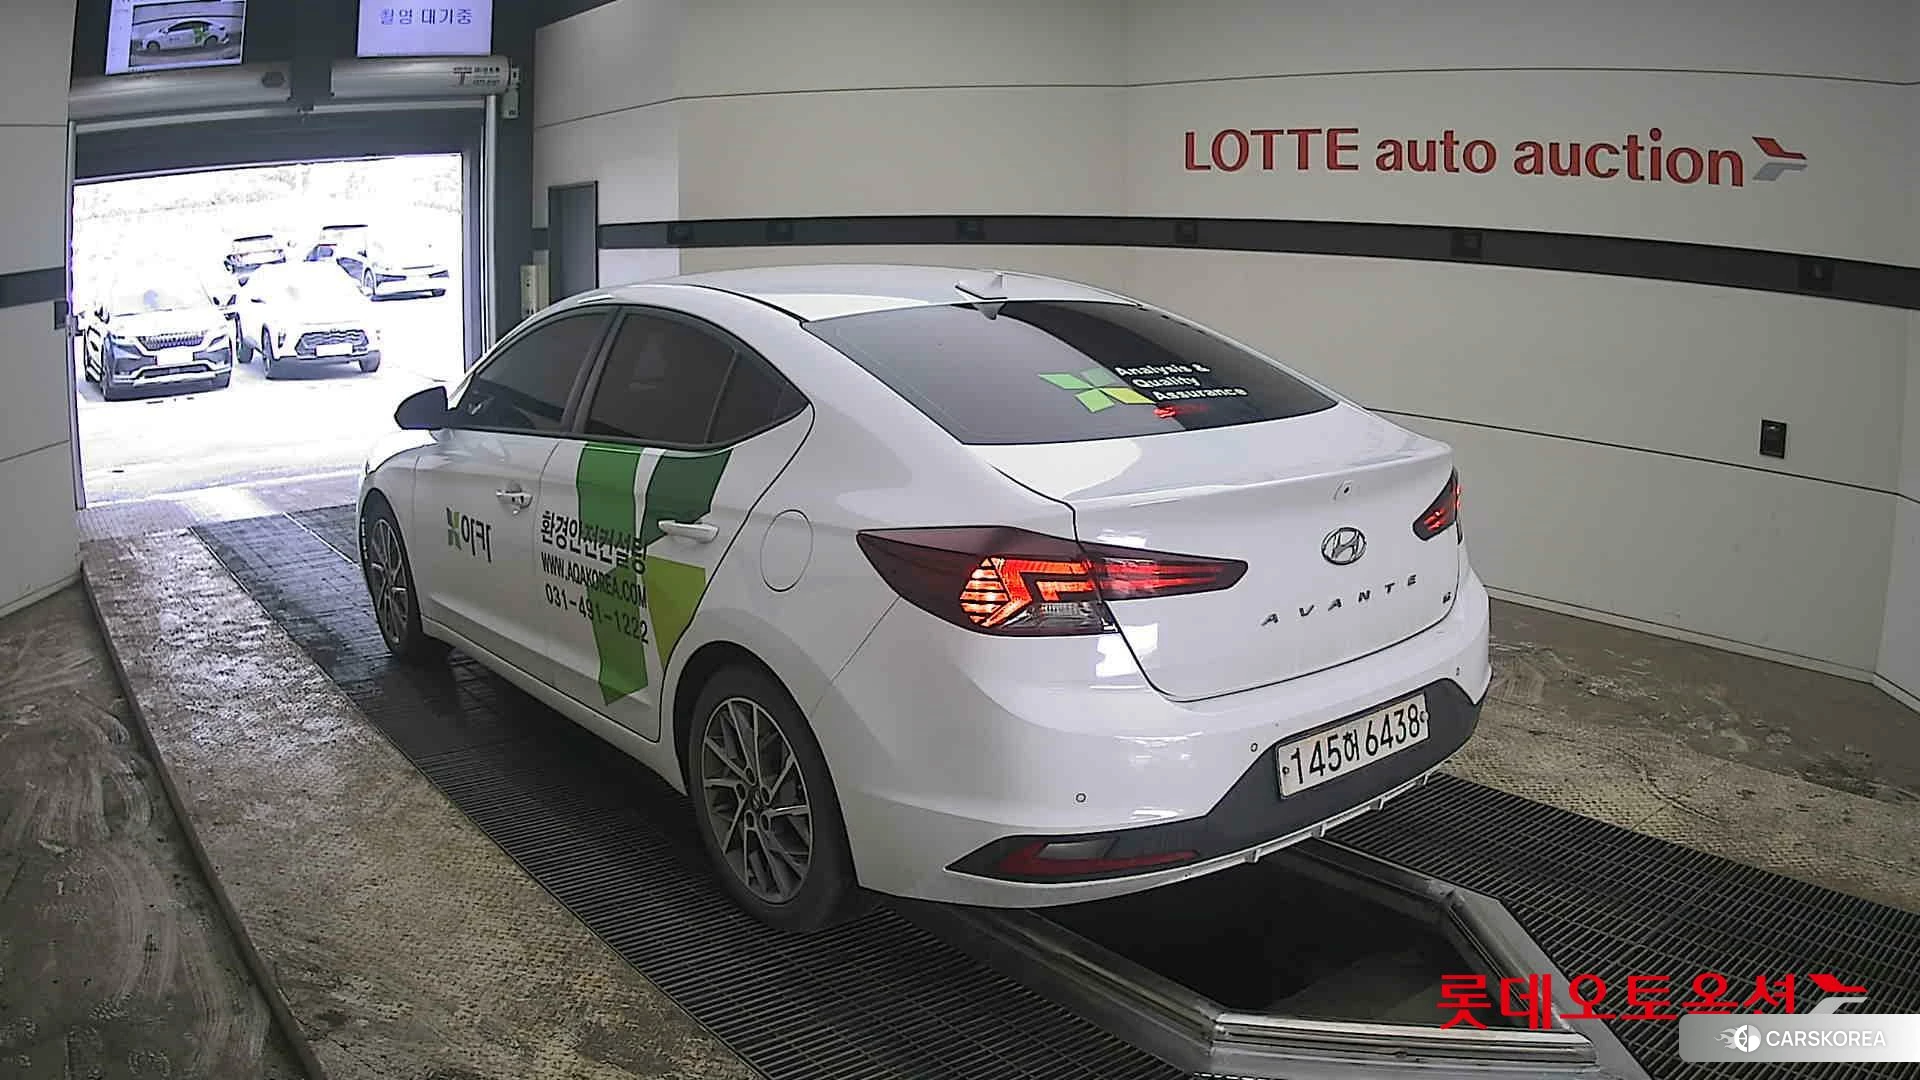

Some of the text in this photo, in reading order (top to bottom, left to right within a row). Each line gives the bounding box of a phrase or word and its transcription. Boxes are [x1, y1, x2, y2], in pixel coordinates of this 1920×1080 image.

[421, 8, 472, 25] 대기중
[1185, 128, 1744, 187] LOTTE auto auction
[1115, 362, 1192, 376] Analysis
[1132, 373, 1201, 389] Quality
[1152, 387, 1248, 401] Assurance
[541, 510, 647, 575] 환경안전컨설팅
[541, 551, 647, 609] WWW.AQAKOREA.COM
[1261, 574, 1417, 627] AVANTE
[545, 583, 648, 644] 031-491-1222
